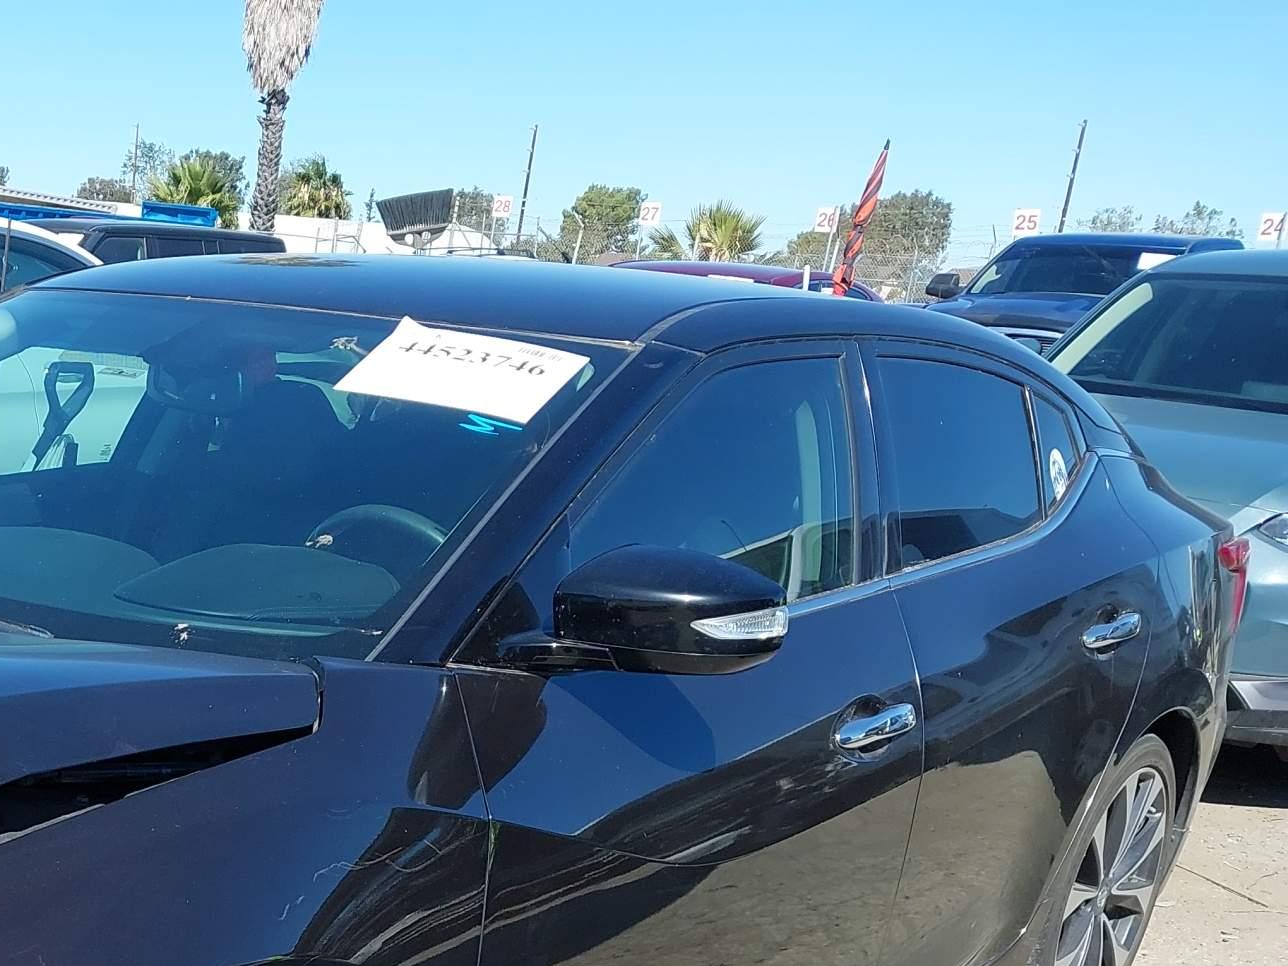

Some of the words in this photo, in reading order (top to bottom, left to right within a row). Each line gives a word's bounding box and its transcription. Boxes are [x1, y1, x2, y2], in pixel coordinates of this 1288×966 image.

[494, 199, 511, 213] 28
[640, 206, 660, 221] 27
[1014, 214, 1039, 231] 25
[1260, 218, 1285, 236] 24
[398, 341, 546, 377] 44523746
